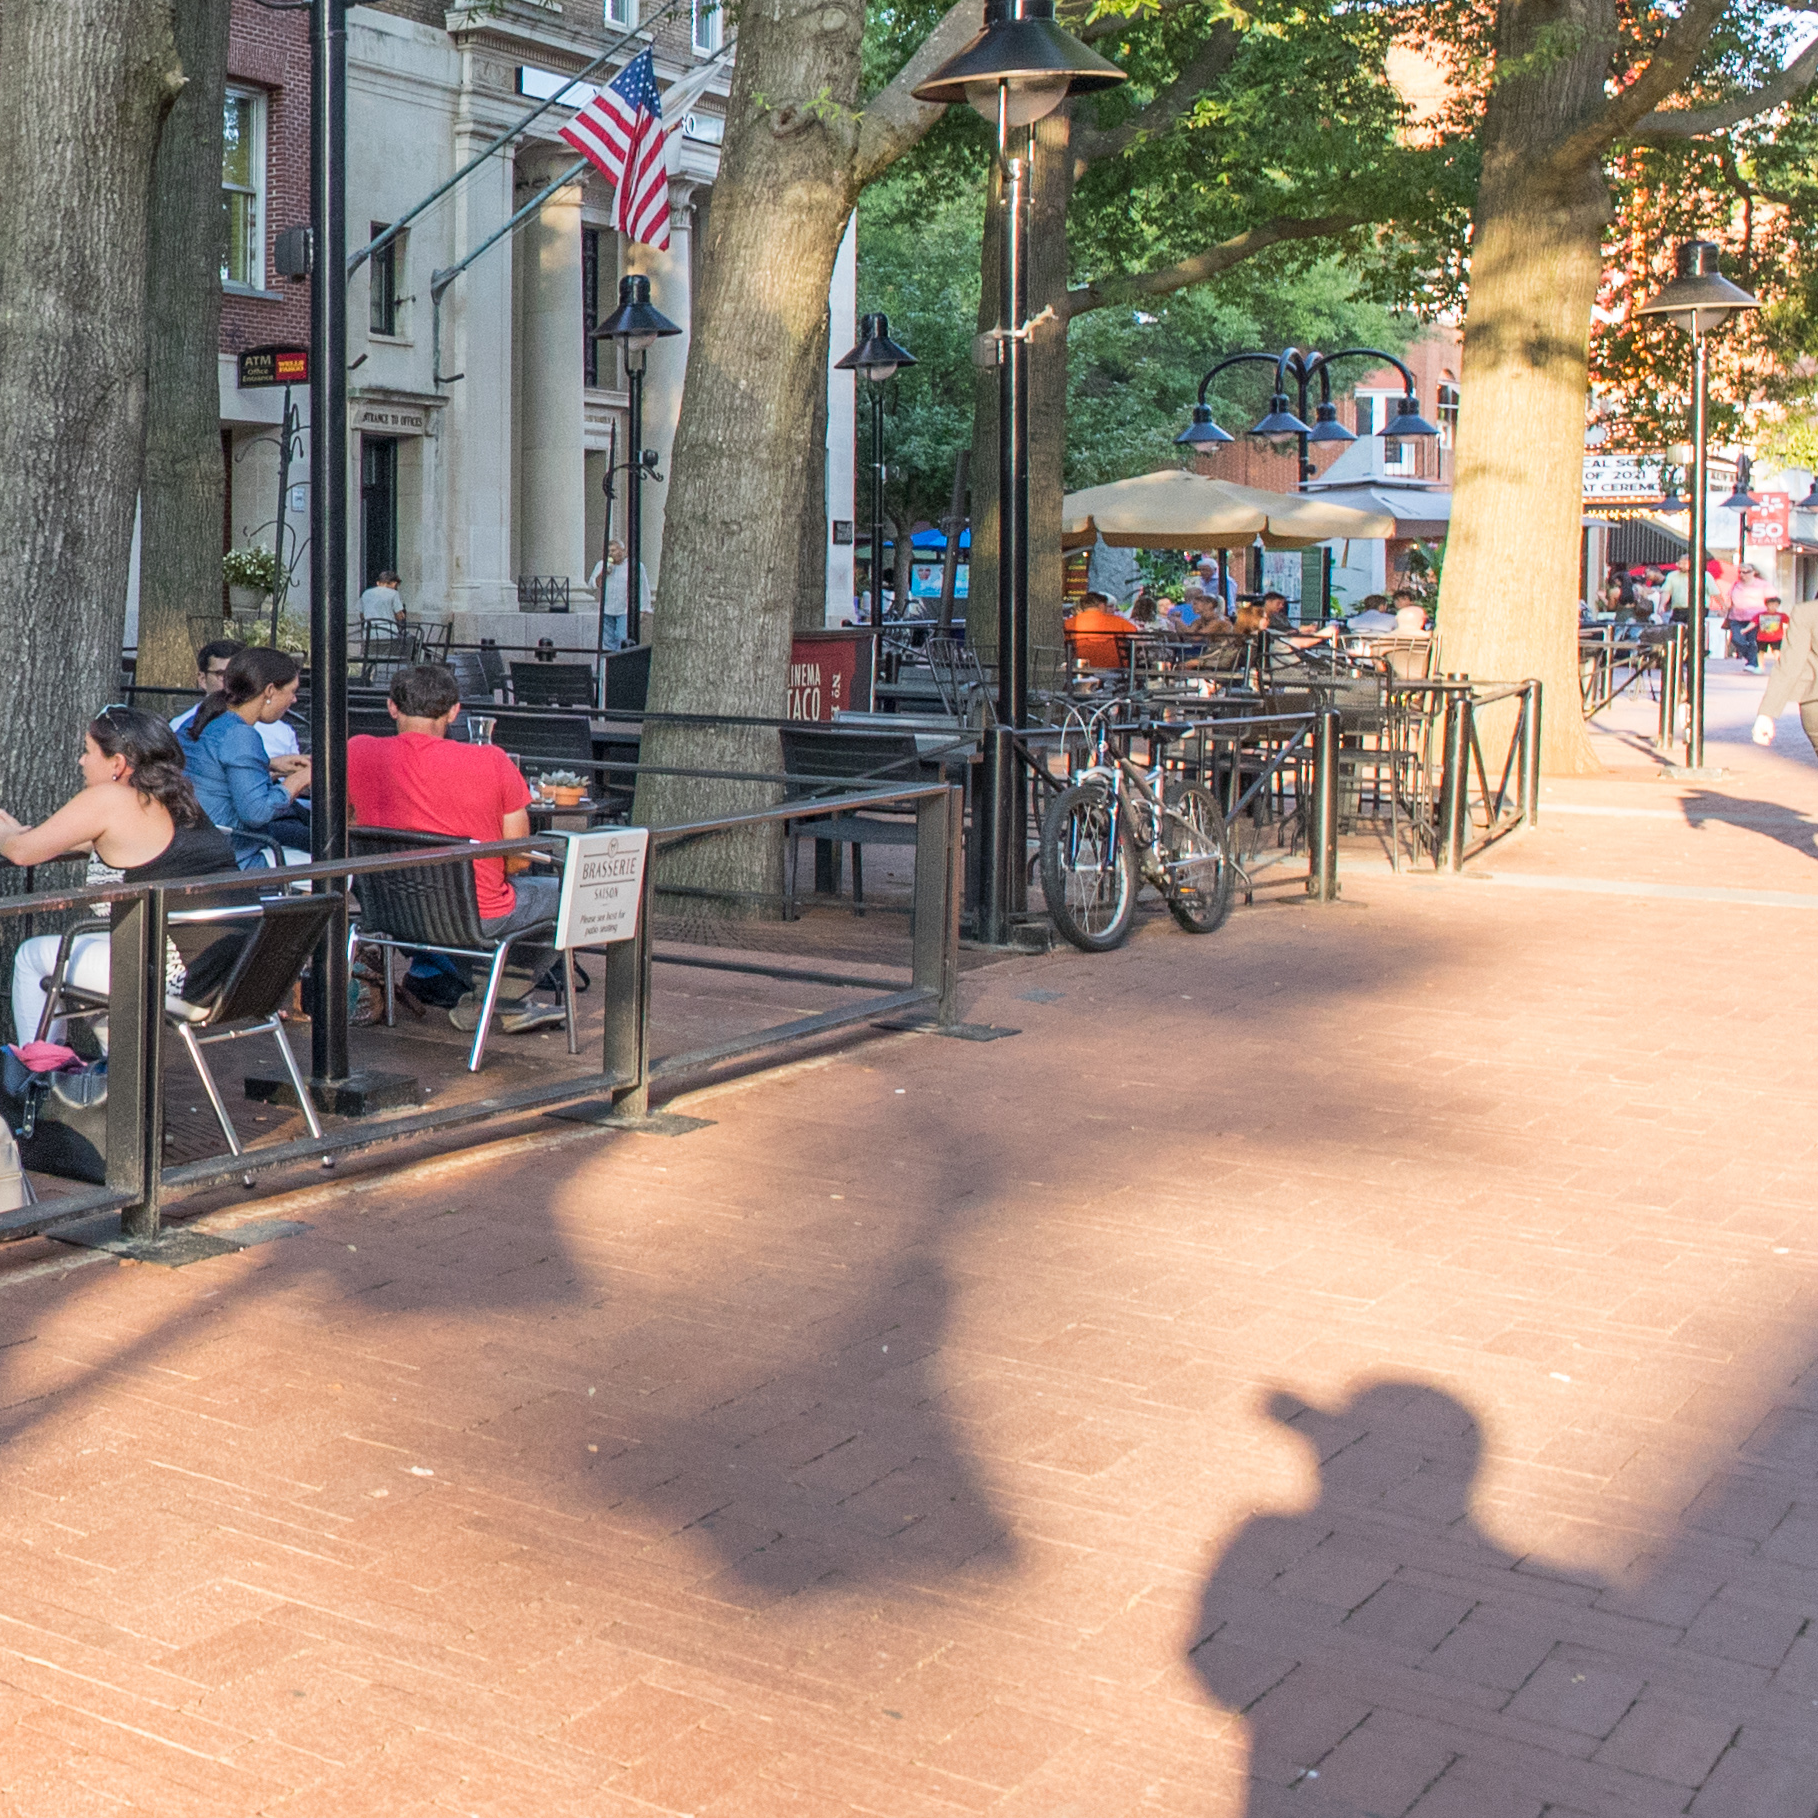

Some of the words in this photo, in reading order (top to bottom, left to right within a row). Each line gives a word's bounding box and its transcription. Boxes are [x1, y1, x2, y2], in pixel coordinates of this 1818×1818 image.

[245, 355, 271, 366] ATM
[243, 374, 274, 382] Entrance
[1585, 471, 1604, 480] OF
[1750, 522, 1784, 540] 50
[788, 663, 821, 687] INEMA
[786, 687, 821, 722] TACO
[582, 857, 637, 880] BRASSERIE
[594, 886, 619, 900] SAISON
[579, 914, 597, 925] Please
[606, 911, 618, 921] host
